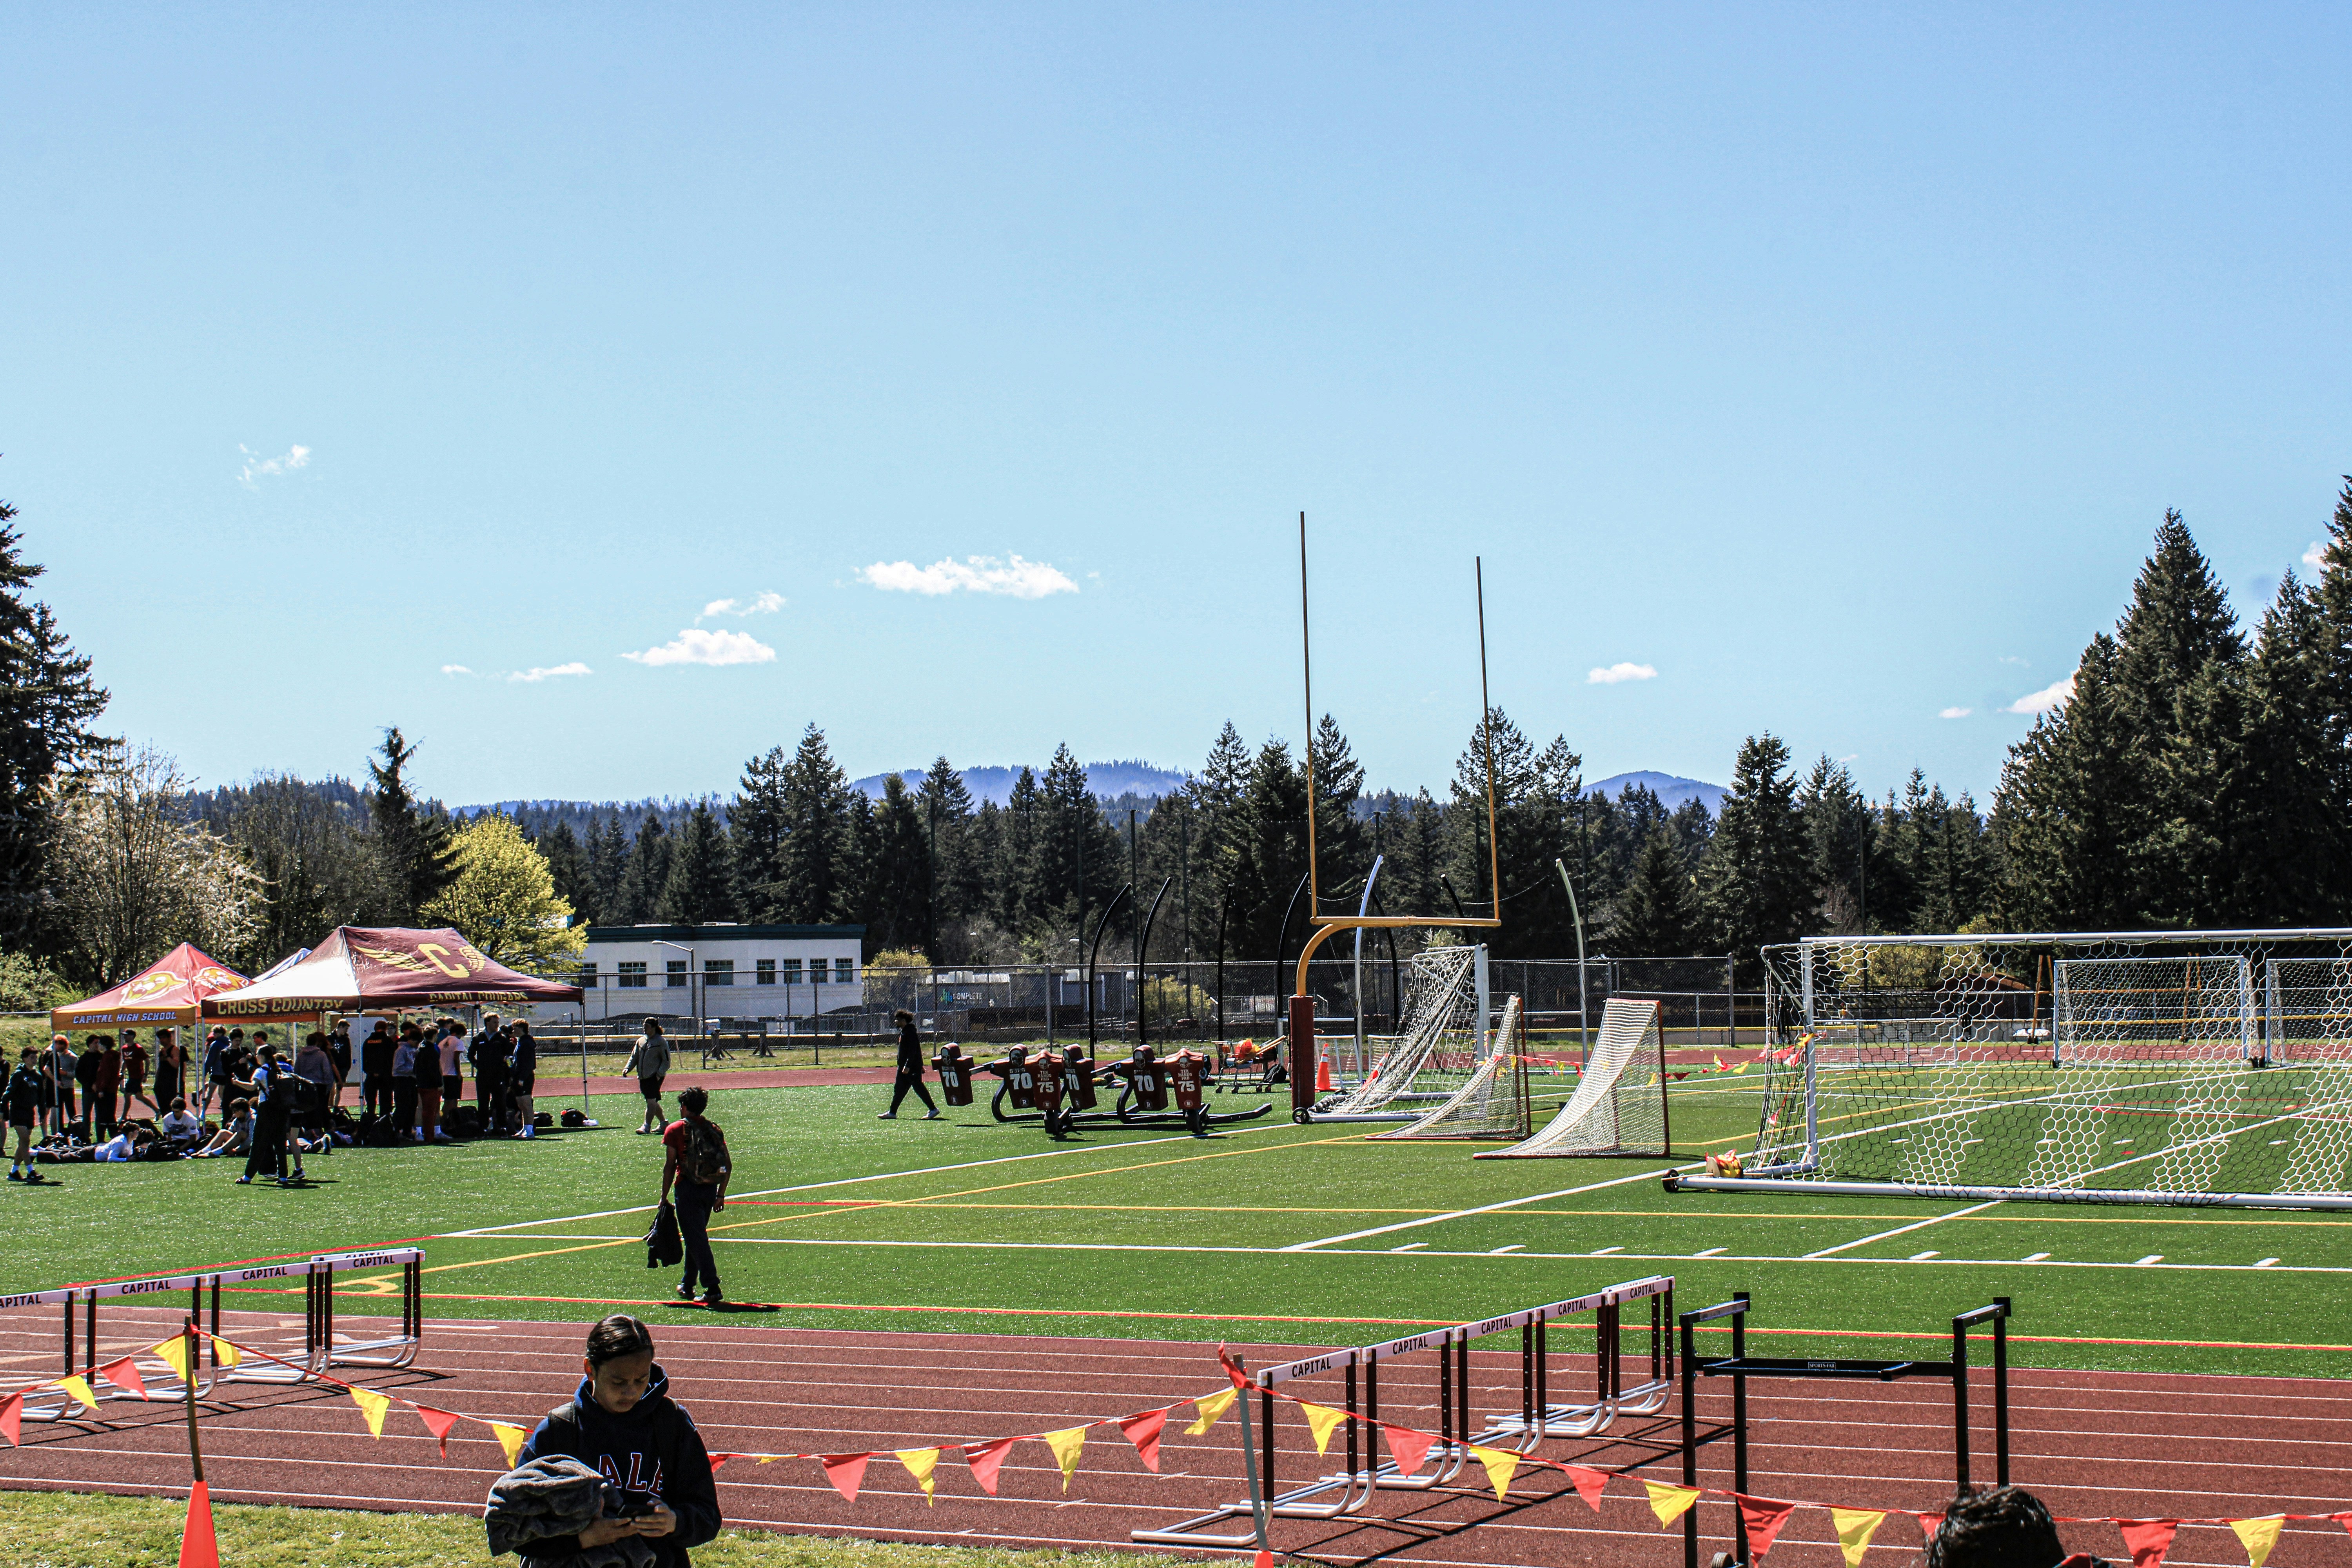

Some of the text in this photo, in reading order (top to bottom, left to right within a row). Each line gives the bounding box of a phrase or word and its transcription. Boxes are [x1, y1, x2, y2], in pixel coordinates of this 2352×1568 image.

[218, 998, 343, 1015] CROSS COUNTRY
[73, 1011, 176, 1024] CAPITAL HIGH SCHOOL
[942, 1071, 959, 1087] 70
[1009, 1073, 1033, 1090] 70
[1065, 1074, 1080, 1090] 70
[1134, 1075, 1154, 1092] 70
[1178, 1080, 1195, 1092] 75
[1037, 1082, 1054, 1093] 75
[353, 1256, 395, 1267] CAPITAL
[243, 1267, 287, 1280] CAPITAL
[122, 1280, 171, 1294] CAPITAL
[1630, 1283, 1655, 1298] CAPITAL
[1558, 1299, 1587, 1315] CAPITAL
[1481, 1317, 1512, 1334] CAPITAL
[1393, 1336, 1428, 1354] CAPITAL
[1292, 1357, 1331, 1377] CAPITAL
